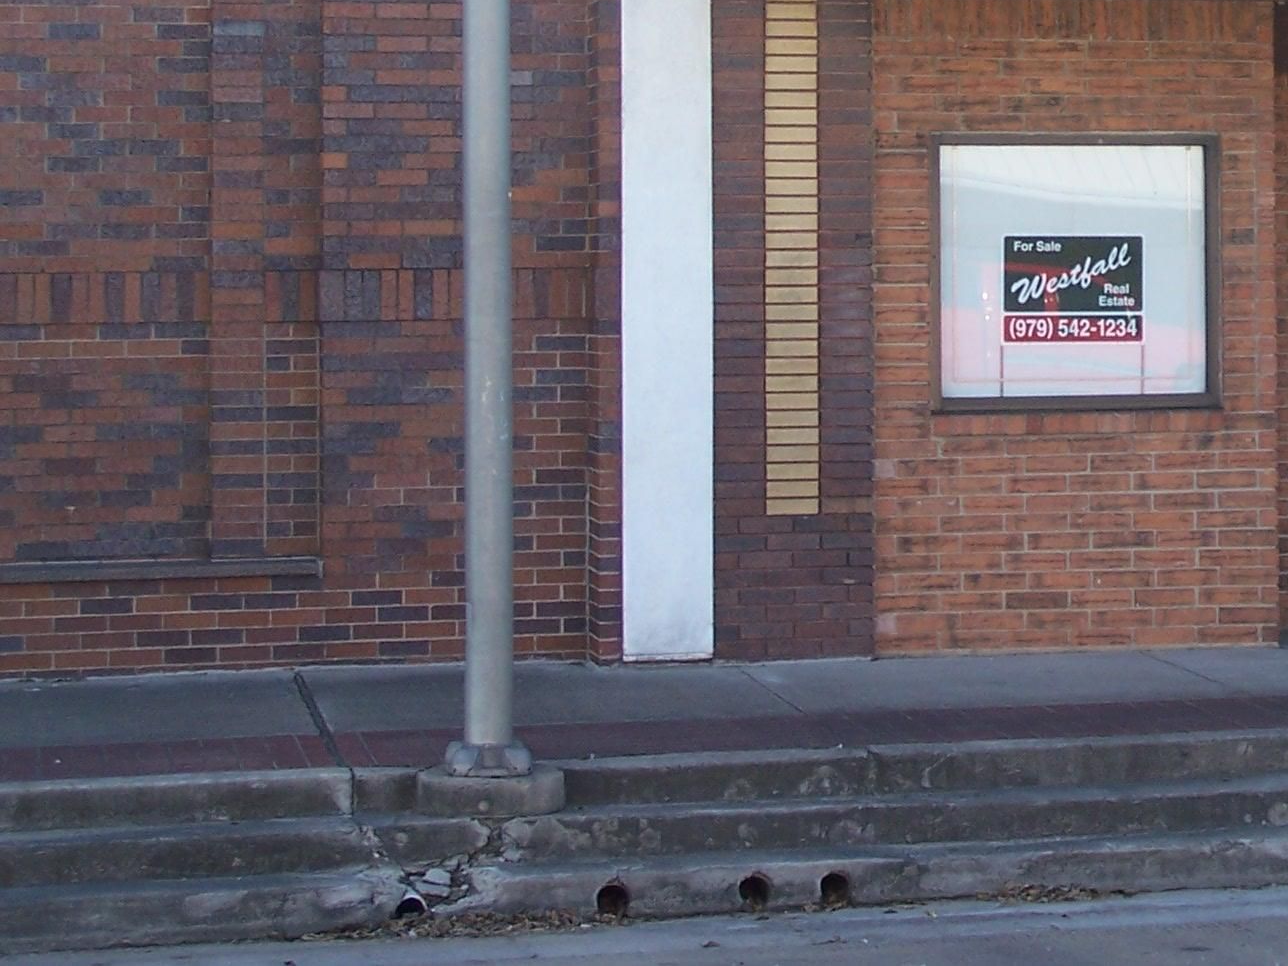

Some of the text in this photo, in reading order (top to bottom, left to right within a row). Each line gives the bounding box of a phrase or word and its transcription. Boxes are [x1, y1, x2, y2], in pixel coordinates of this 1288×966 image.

[1013, 241, 1062, 252] For Sale
[1010, 242, 1132, 304] Westfall
[1103, 283, 1130, 294] Real
[1098, 296, 1135, 306] Estate
[1009, 318, 1138, 339] (979) 542-1234
